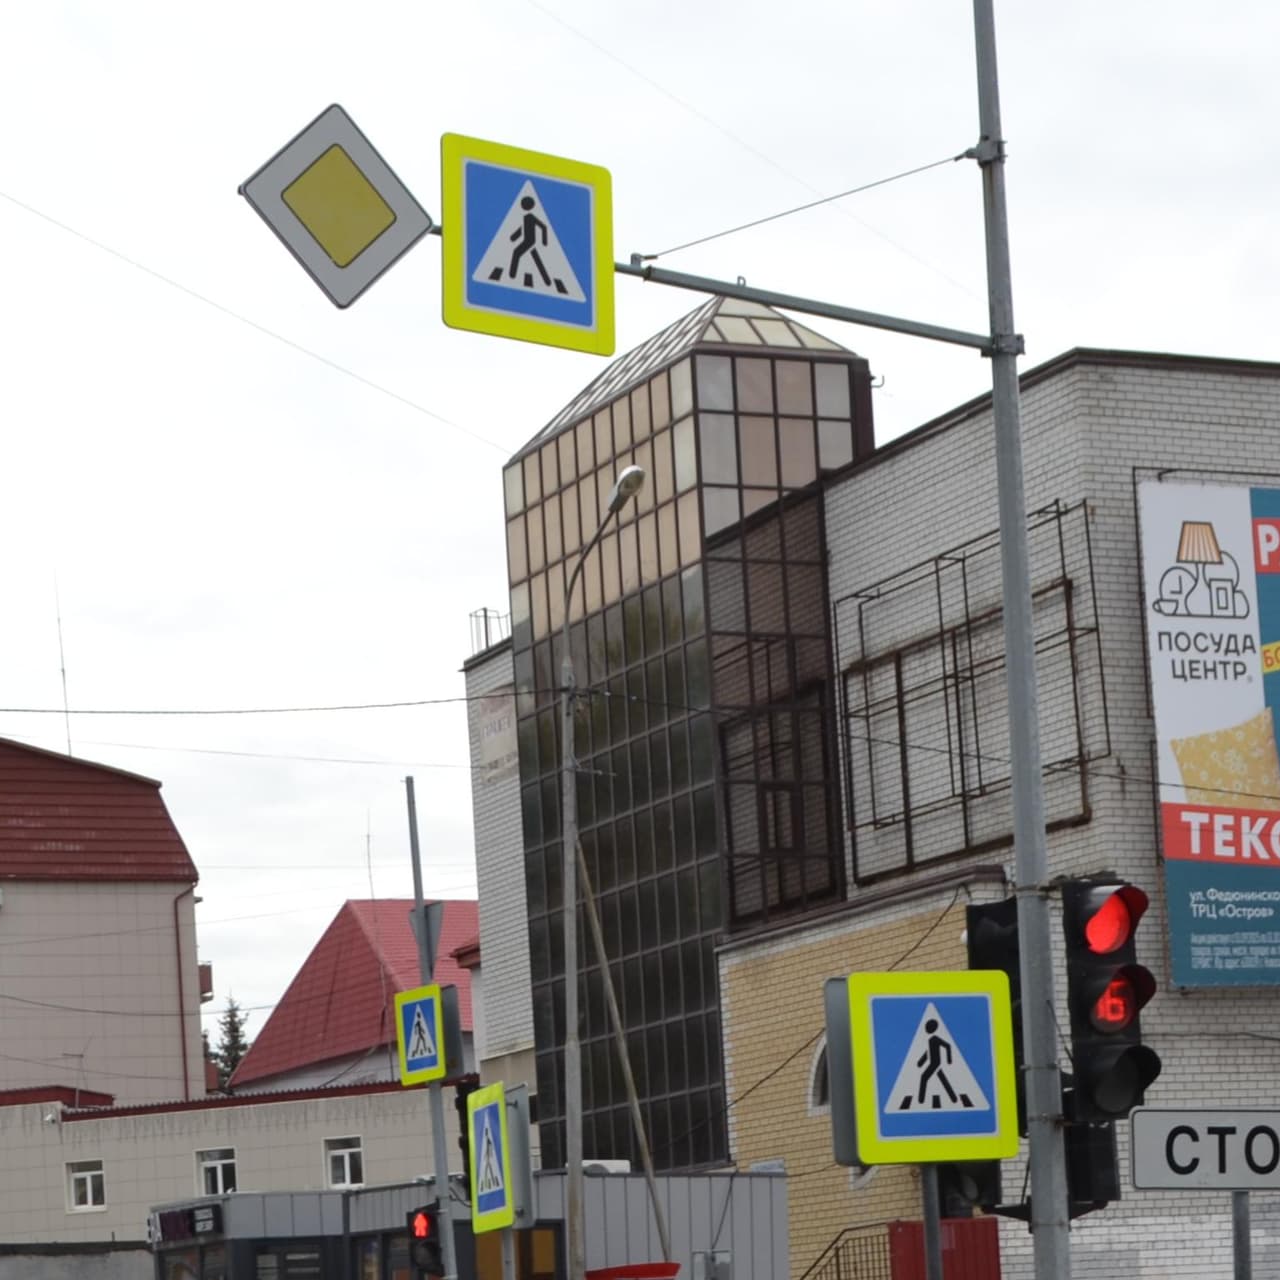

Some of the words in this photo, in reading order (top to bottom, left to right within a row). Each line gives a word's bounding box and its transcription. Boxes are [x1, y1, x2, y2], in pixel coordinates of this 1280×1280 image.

[1157, 631, 1257, 655] ПОСУДА
[1171, 660, 1248, 682] ЦЕНТР
[1191, 904, 1217, 918] ТРЦ
